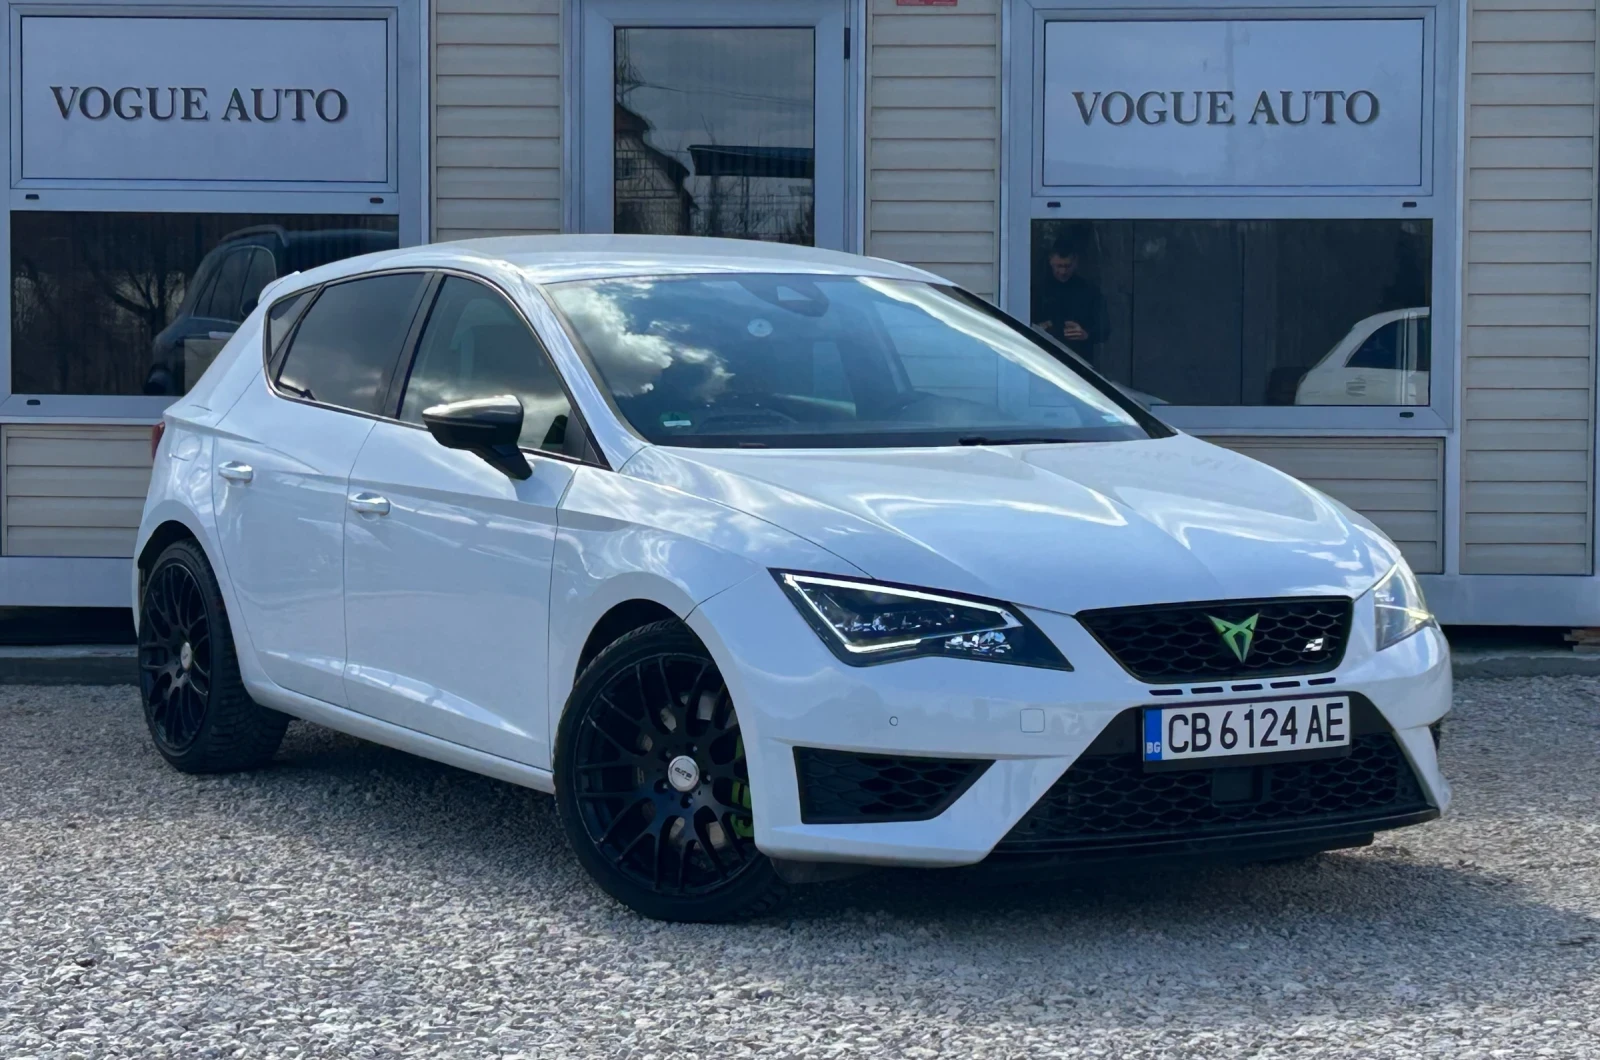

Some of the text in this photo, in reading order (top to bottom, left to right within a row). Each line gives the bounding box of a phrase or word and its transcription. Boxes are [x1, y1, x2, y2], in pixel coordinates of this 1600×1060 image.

[50, 86, 348, 122] VOGUE AUTO
[1072, 90, 1379, 126] VOGUE AUTO
[1168, 702, 1345, 753] CB 6124 AE
[1146, 741, 1161, 754] BG
